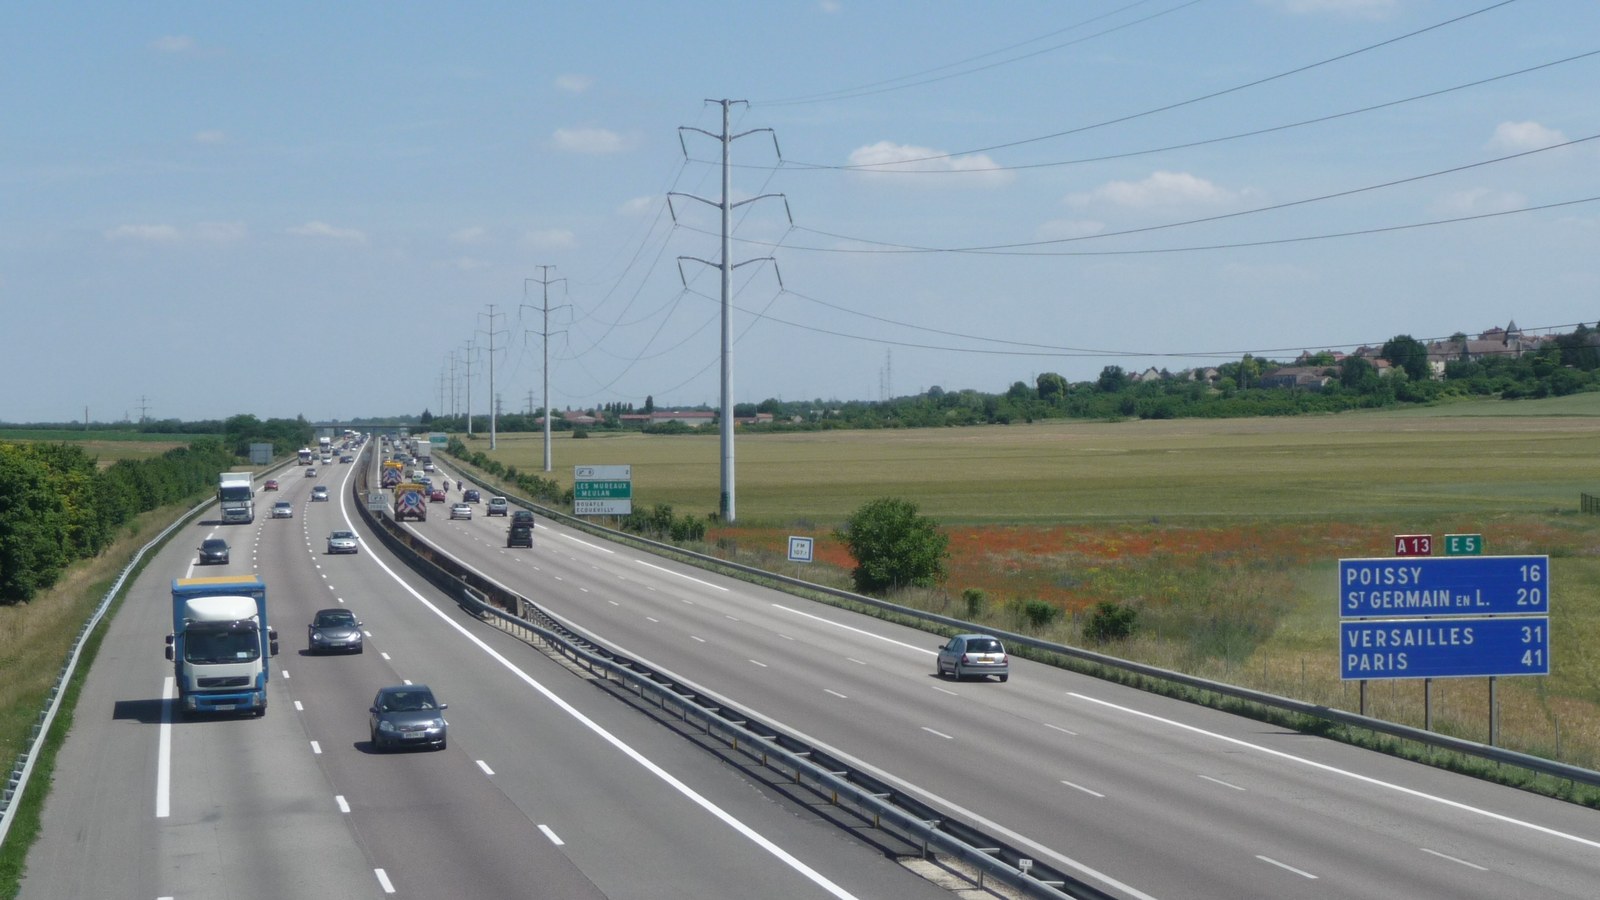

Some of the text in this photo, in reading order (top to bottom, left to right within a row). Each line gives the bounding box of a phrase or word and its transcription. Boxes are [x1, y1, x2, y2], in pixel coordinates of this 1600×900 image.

[1397, 538, 1430, 553] A 13
[1452, 537, 1475, 552] E 5
[1347, 567, 1421, 585] POISSY
[1520, 565, 1541, 582] 16
[1348, 590, 1490, 609] ST GERMAIN EN L.
[1517, 588, 1541, 605] 20
[1348, 628, 1474, 648] VERSAILLES
[1521, 626, 1542, 643] 31
[1348, 653, 1408, 671] PARIS
[1521, 650, 1542, 666] 41
